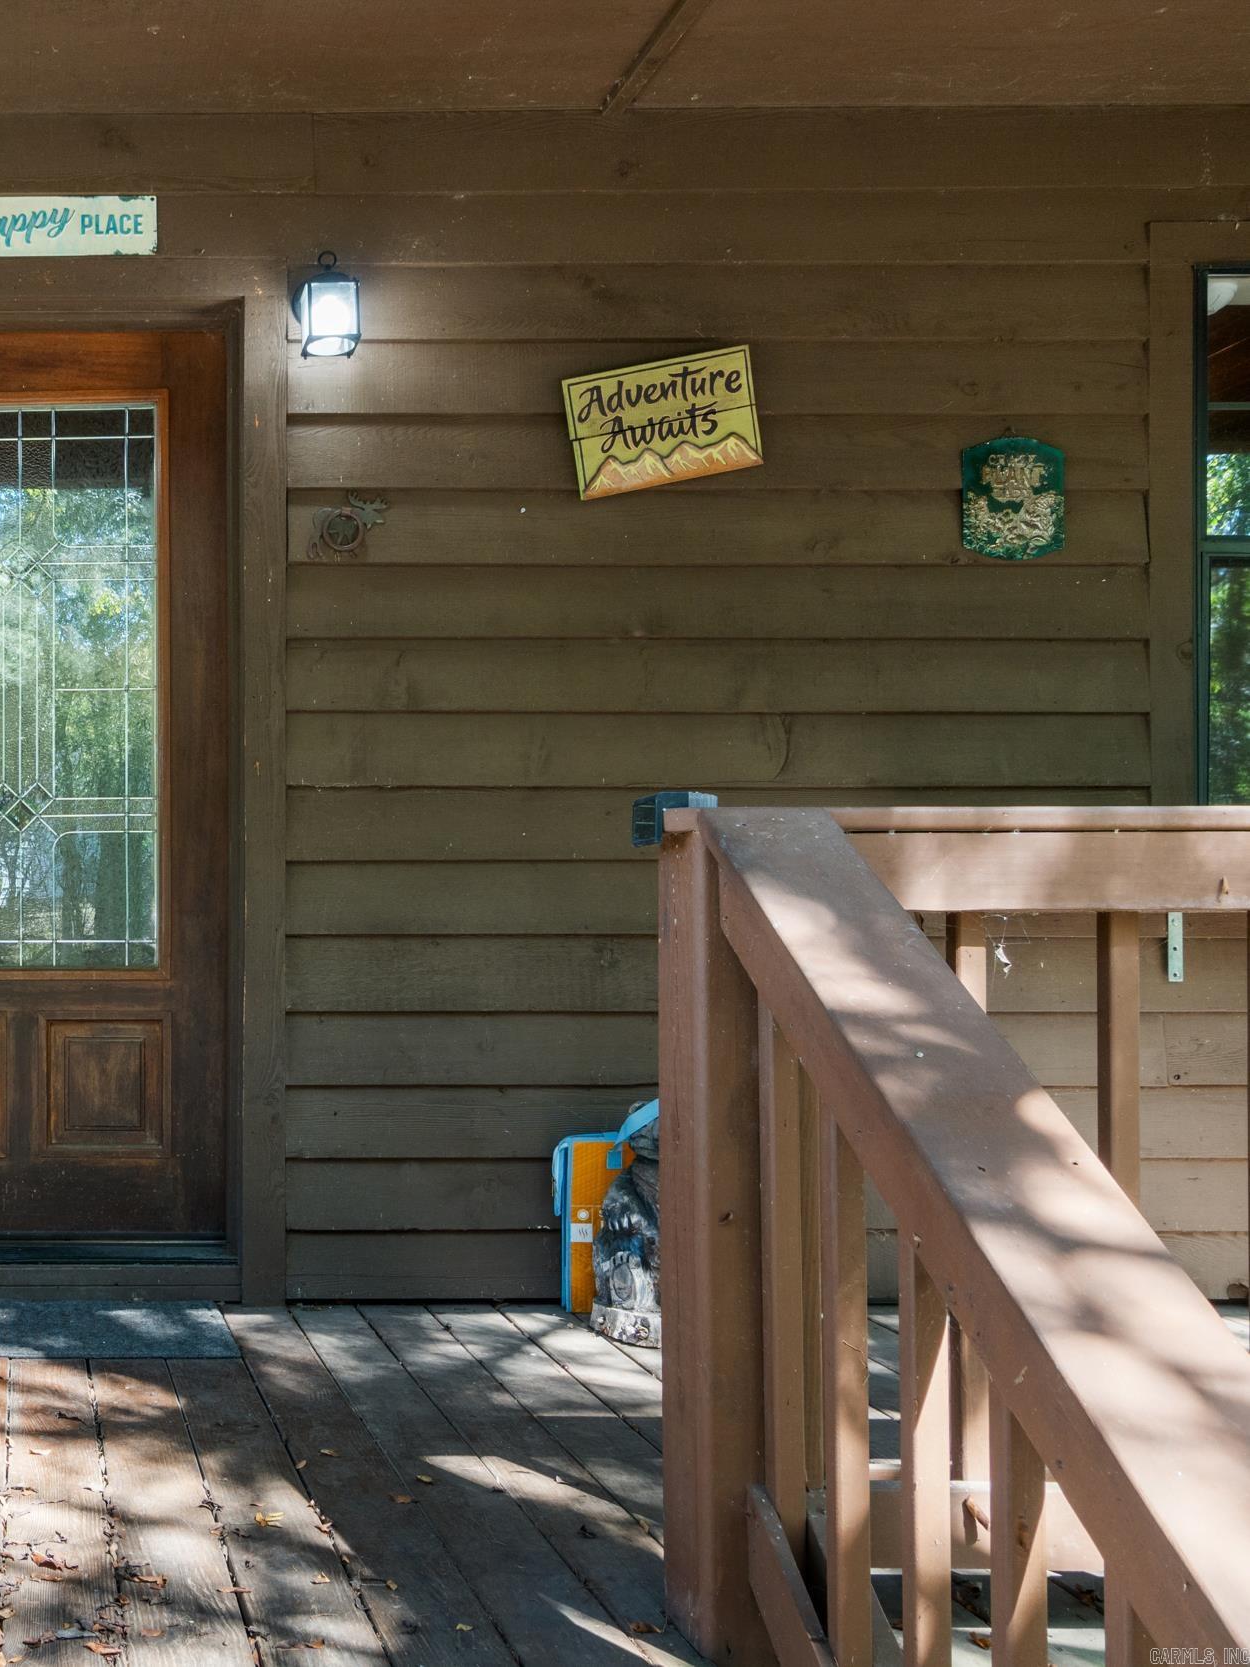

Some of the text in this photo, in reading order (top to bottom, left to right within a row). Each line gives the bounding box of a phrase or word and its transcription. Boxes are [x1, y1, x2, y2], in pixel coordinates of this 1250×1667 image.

[80, 213, 144, 236] PLACE
[577, 366, 743, 424] Adventure
[600, 401, 719, 454] Awaits
[981, 463, 1046, 489] PLANT
